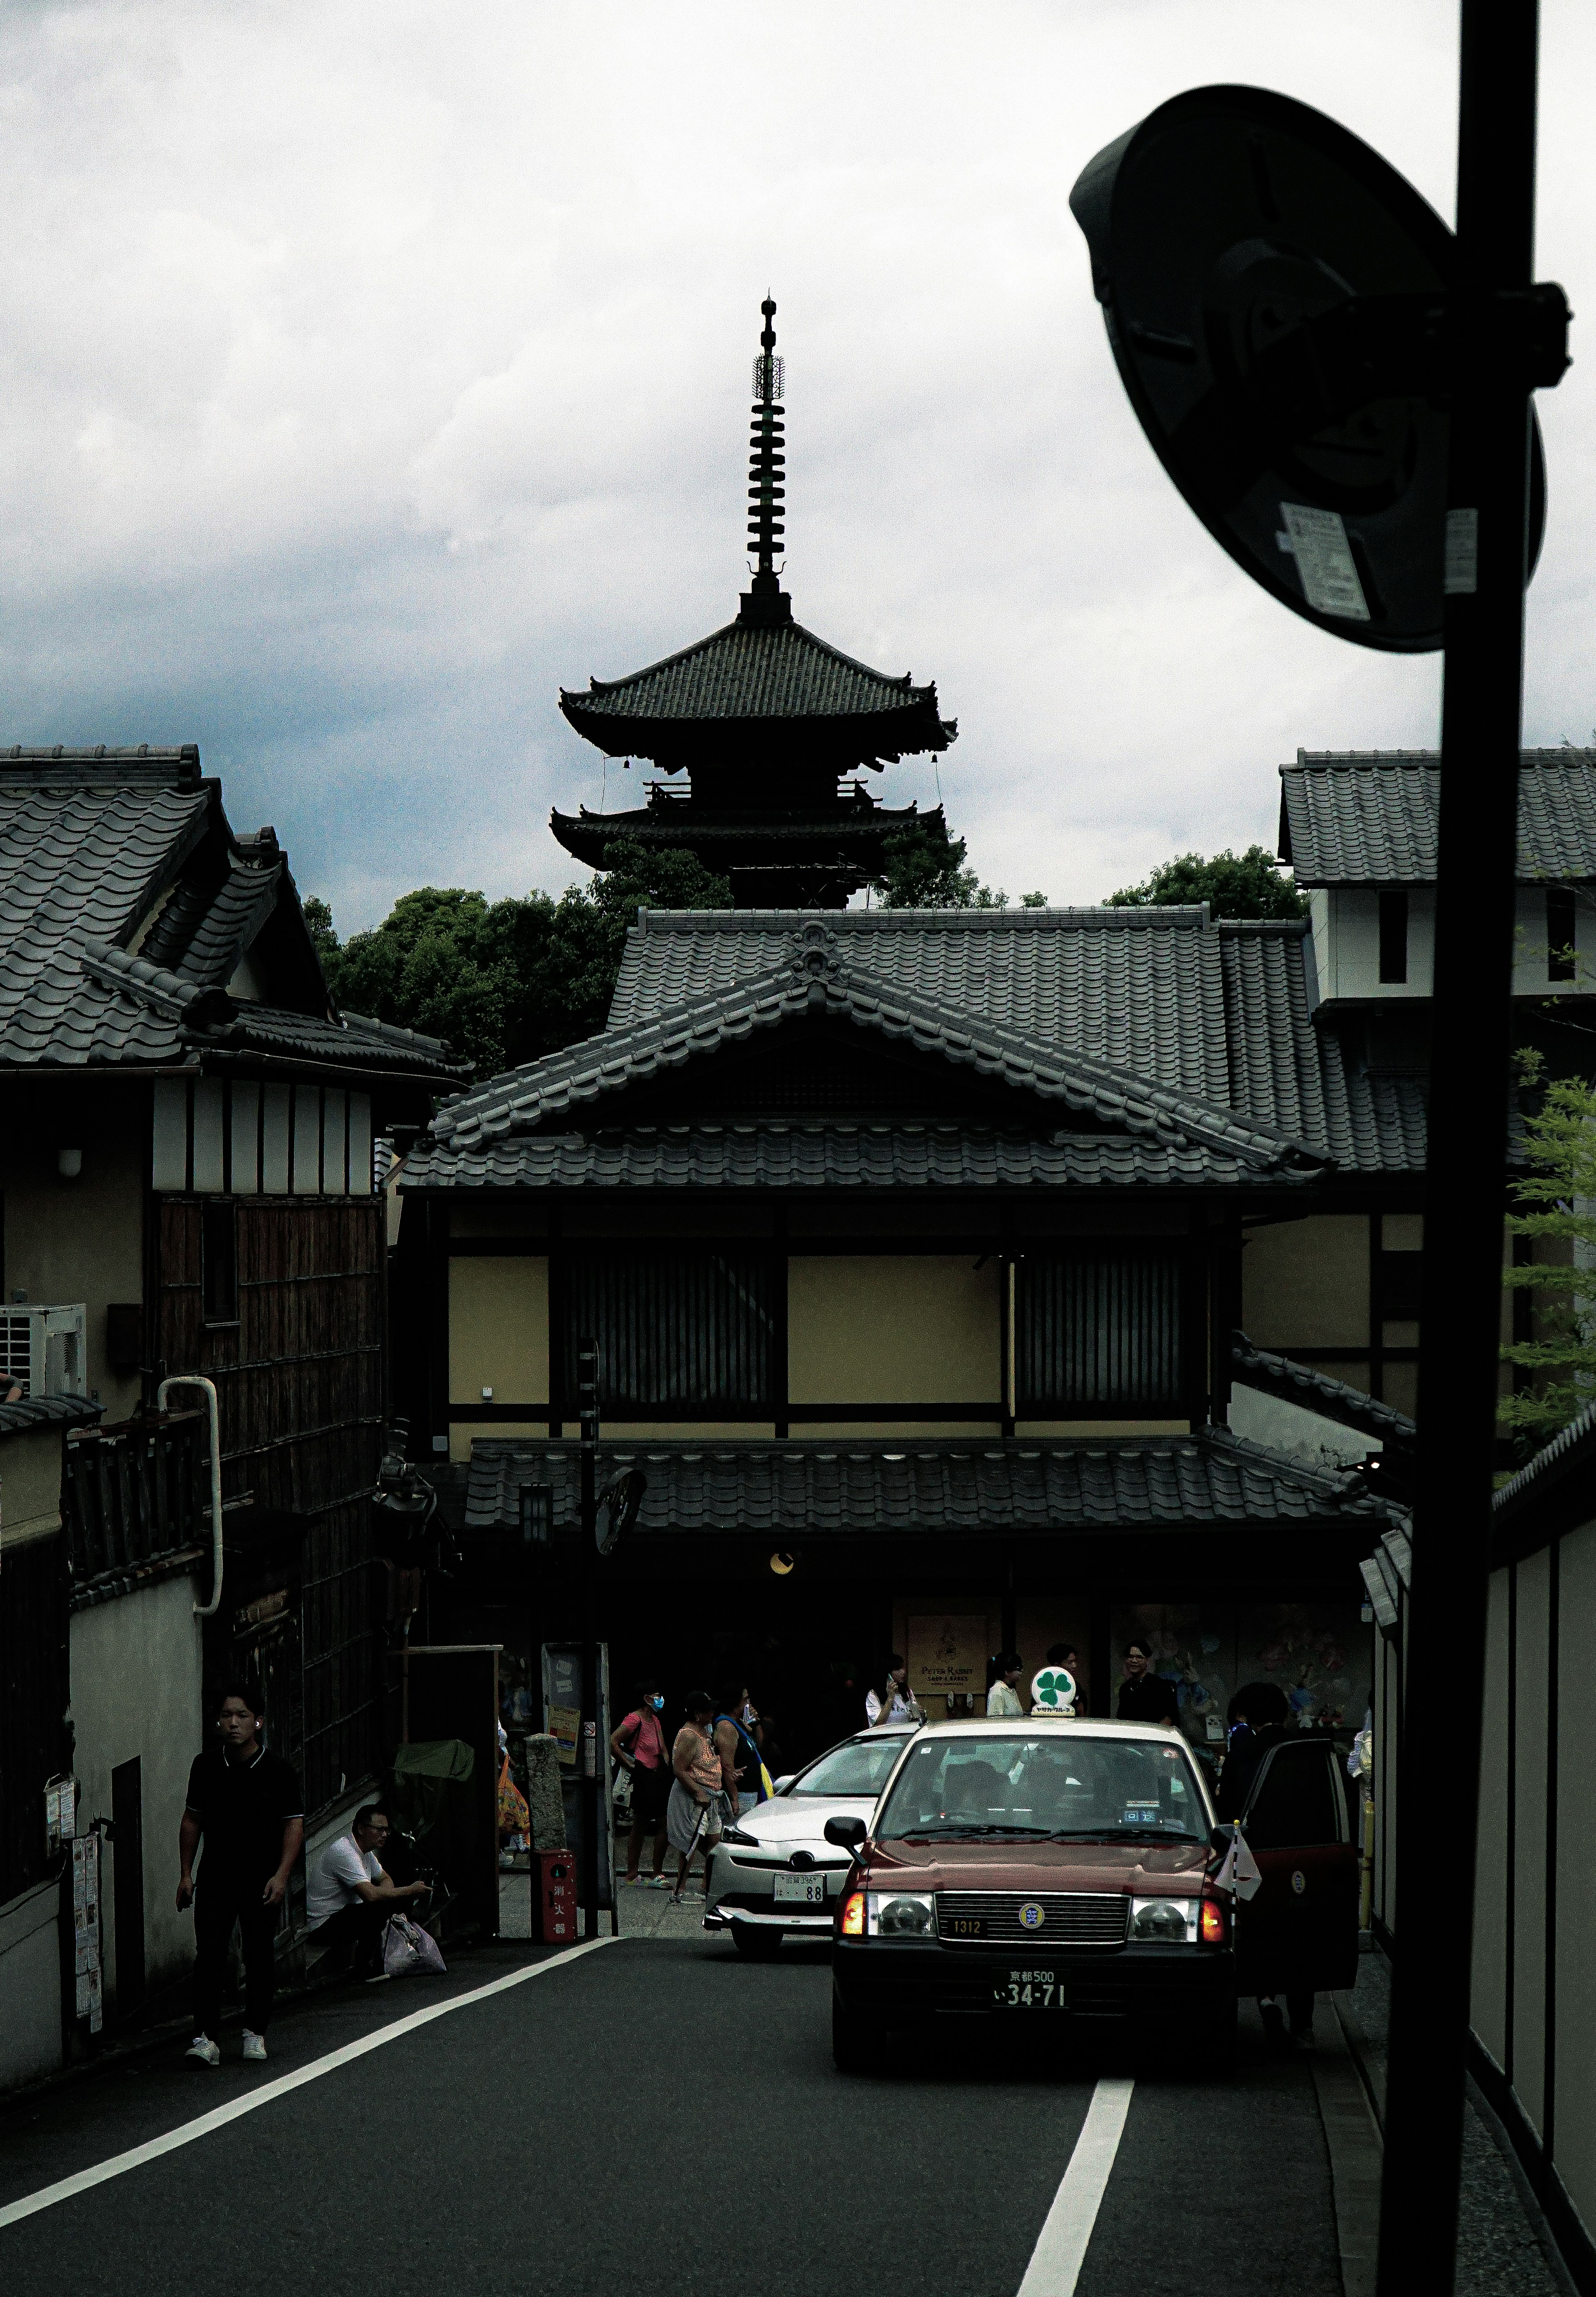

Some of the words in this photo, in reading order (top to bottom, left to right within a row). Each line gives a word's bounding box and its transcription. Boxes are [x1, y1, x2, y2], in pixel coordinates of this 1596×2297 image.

[554, 1885, 565, 1934] 消火器
[955, 1920, 980, 1933] 1312
